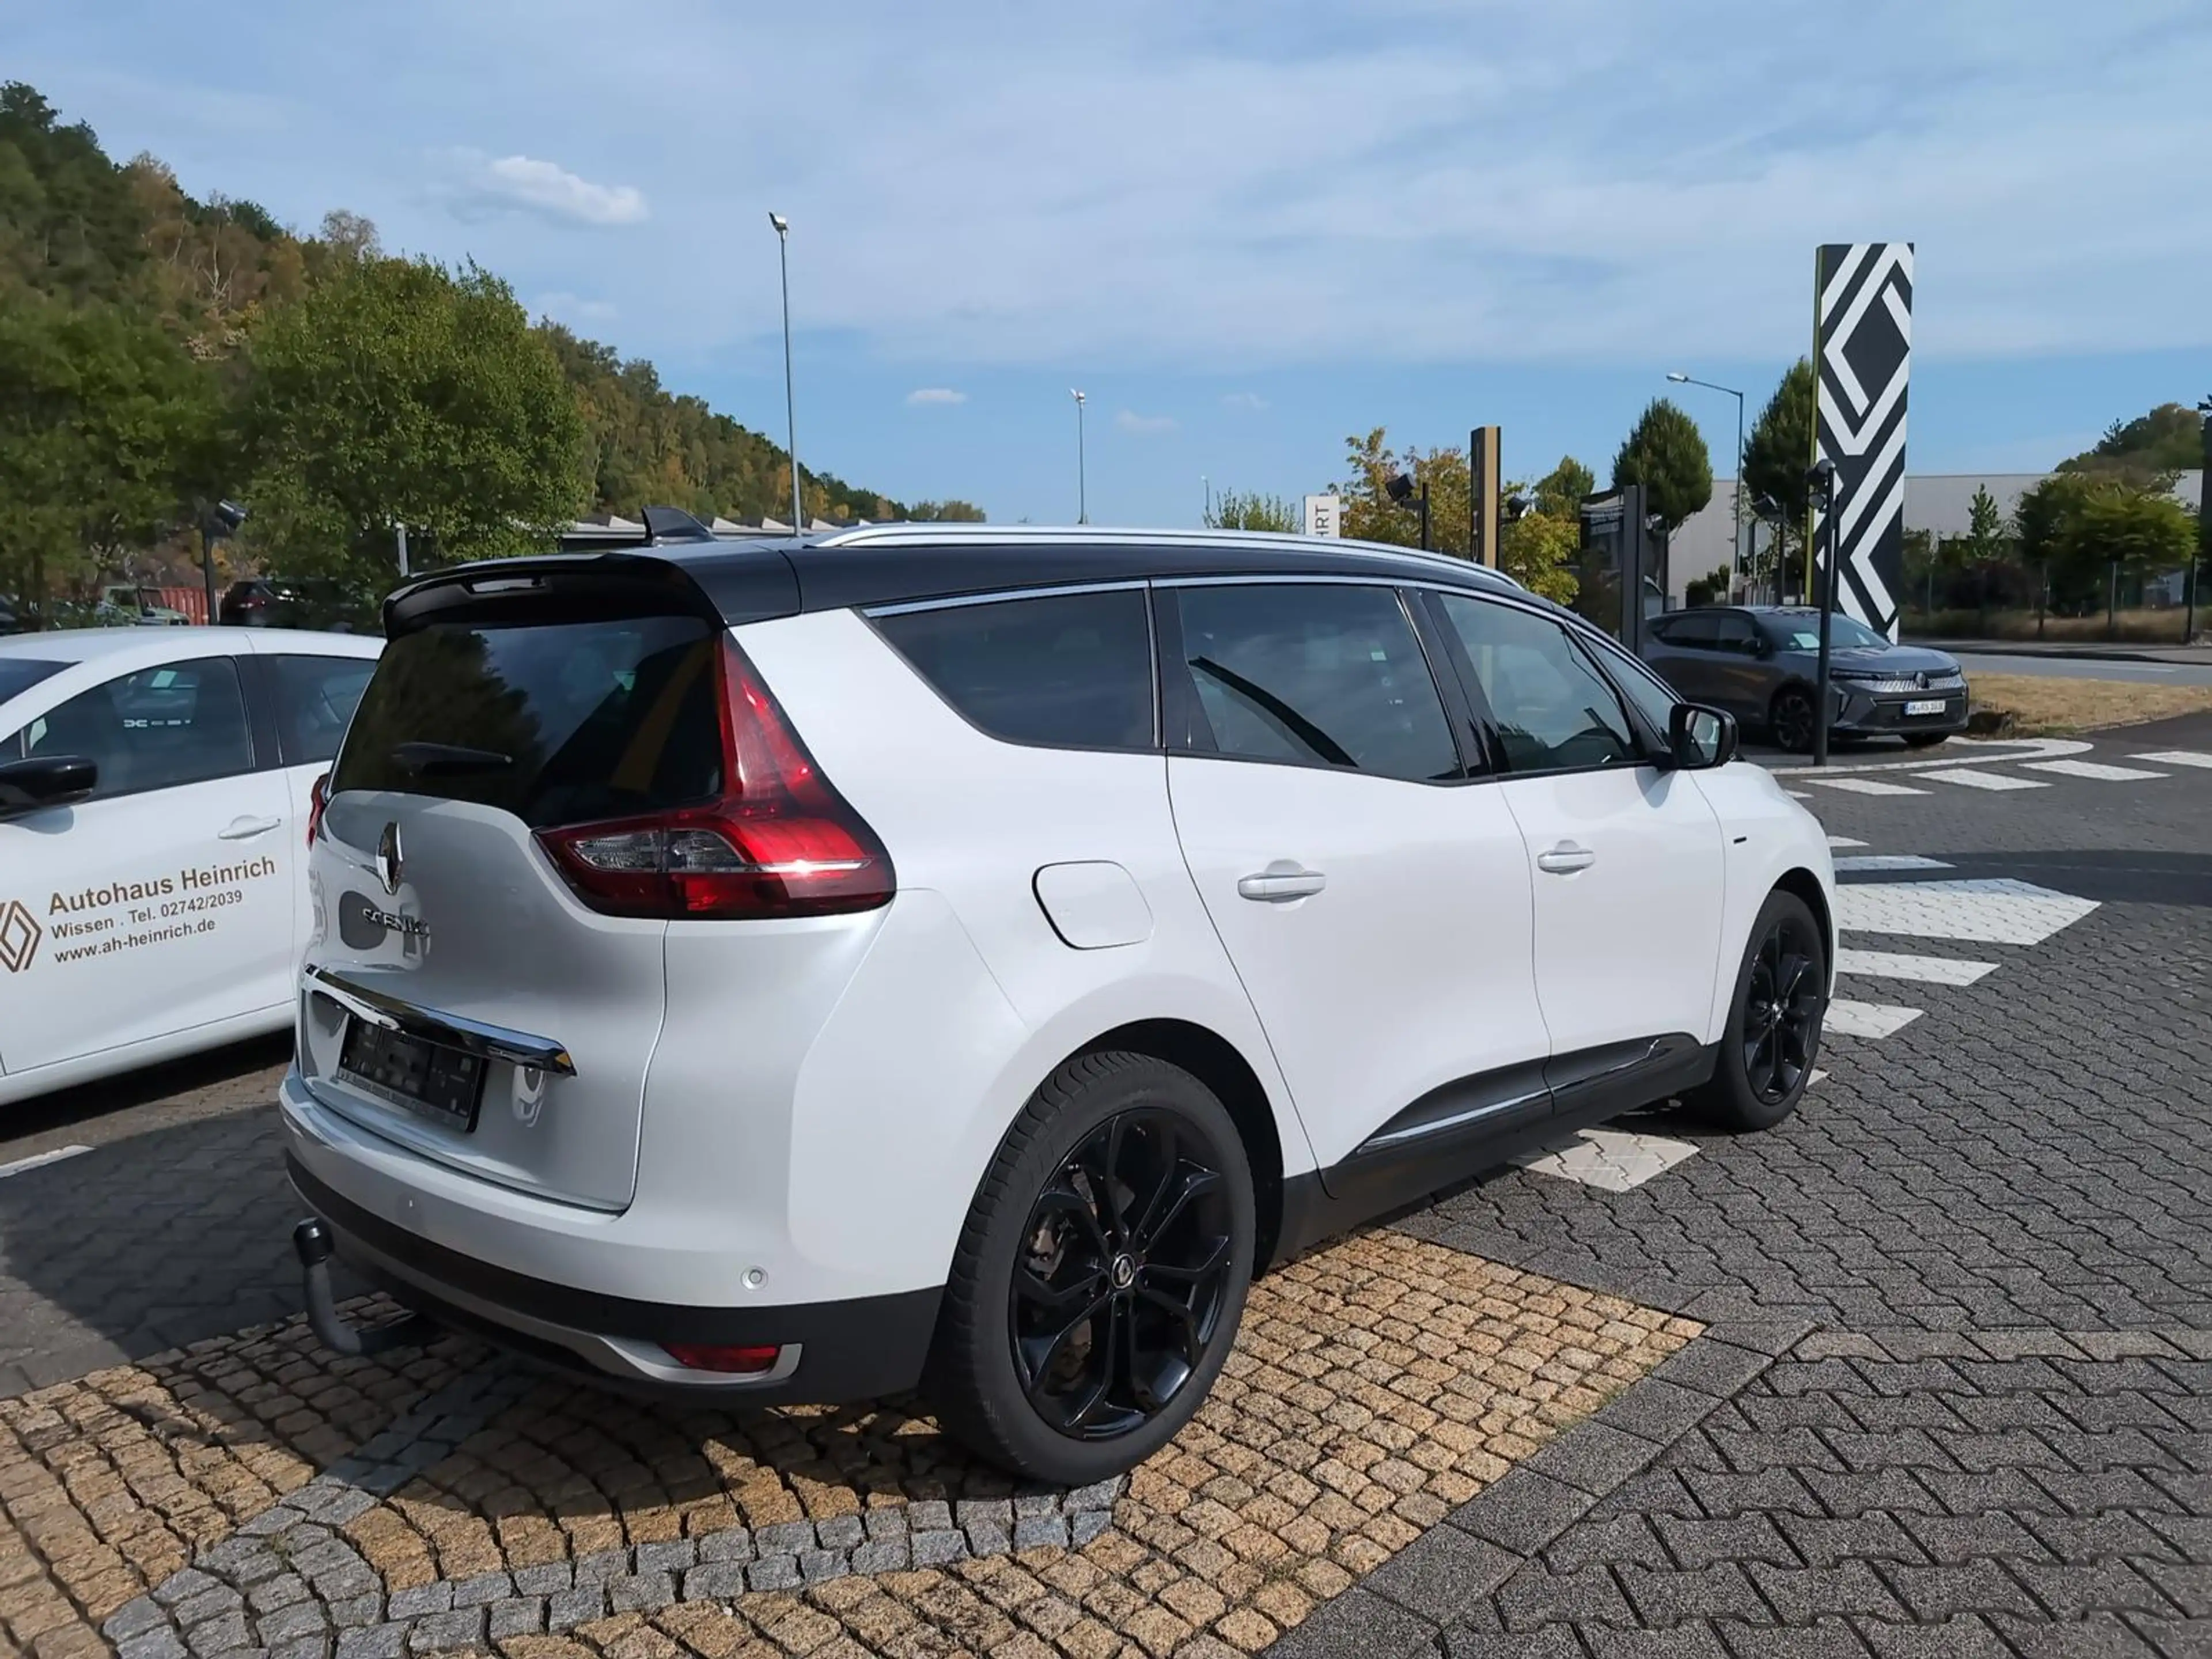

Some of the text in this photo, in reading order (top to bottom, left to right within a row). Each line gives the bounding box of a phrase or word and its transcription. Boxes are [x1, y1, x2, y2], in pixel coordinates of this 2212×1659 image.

[48, 857, 275, 915] Autohaus Heinrich
[51, 918, 114, 940] Wissen
[128, 908, 156, 924] Tel.
[161, 890, 243, 918] 02742/2039
[54, 918, 216, 964] www.ah-heinrich.de
